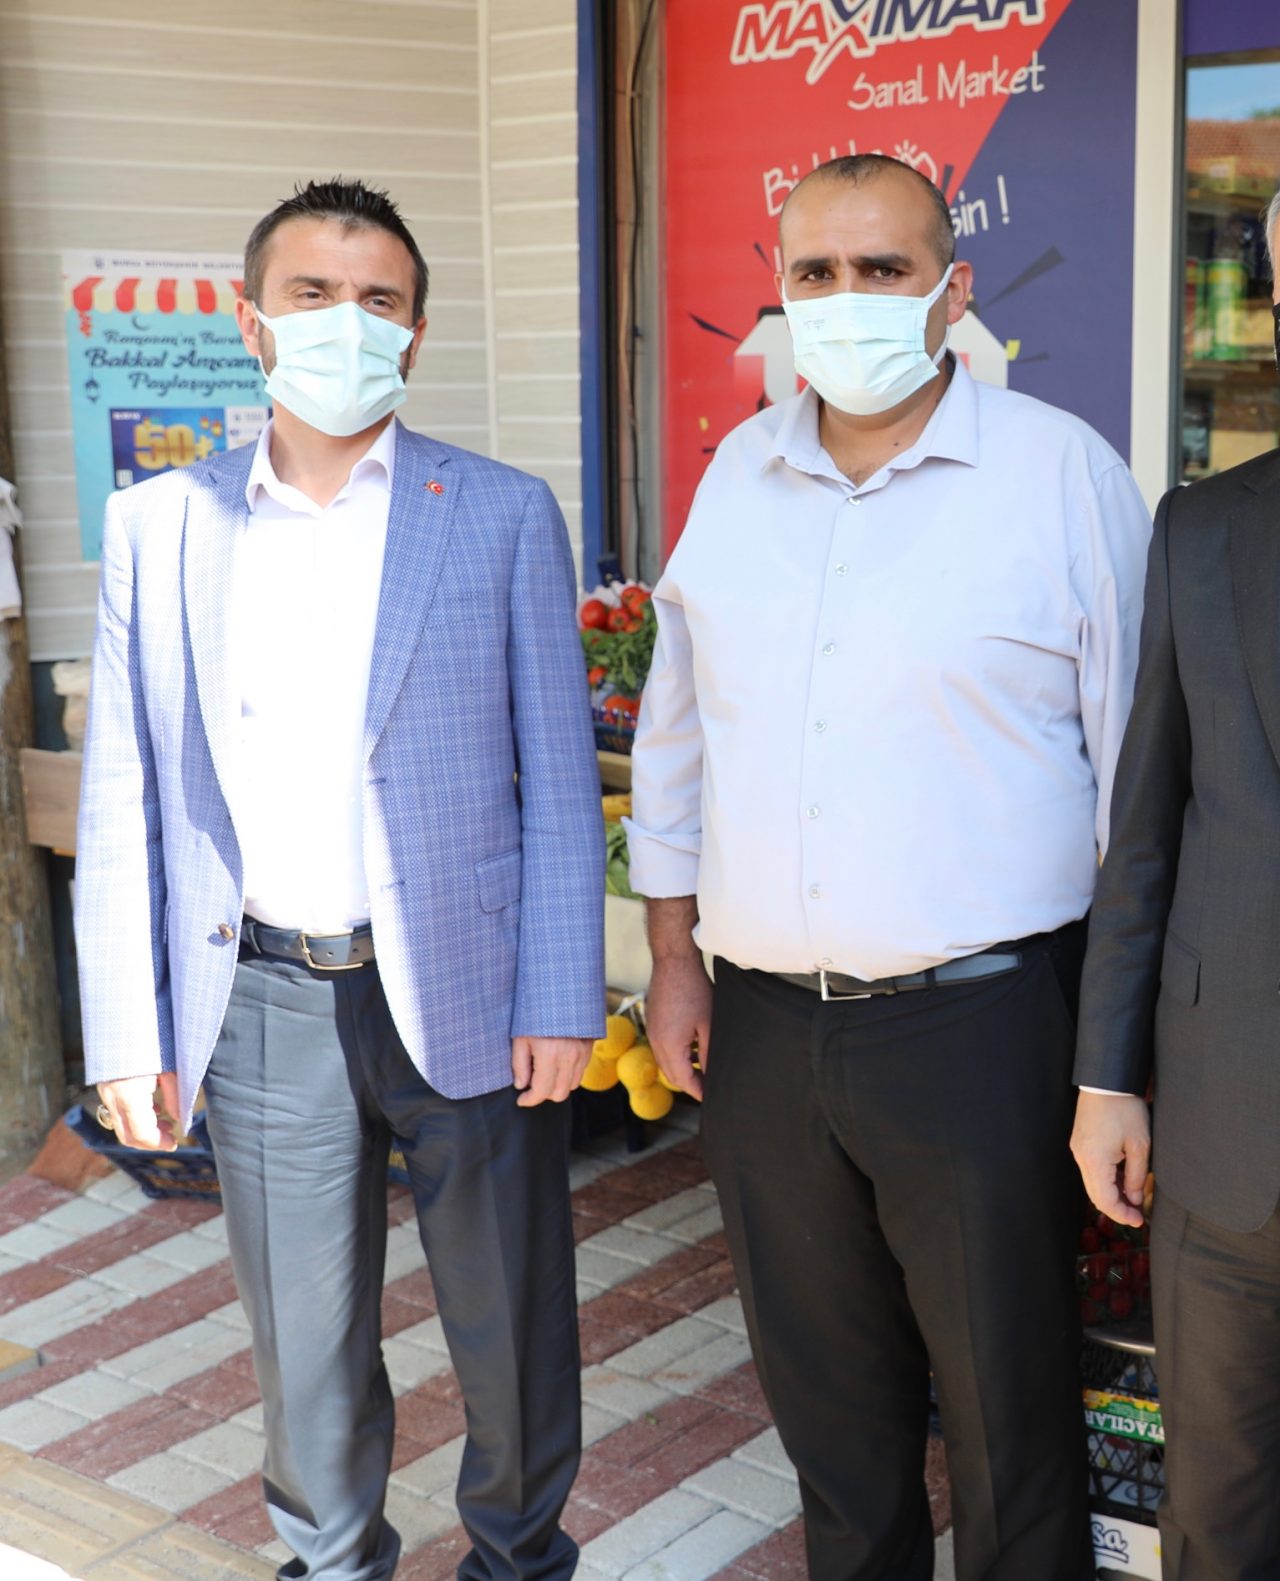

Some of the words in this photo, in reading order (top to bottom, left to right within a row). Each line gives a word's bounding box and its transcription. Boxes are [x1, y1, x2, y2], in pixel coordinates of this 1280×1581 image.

[848, 65, 929, 110] Sanal
[937, 51, 1046, 108] Market
[84, 349, 168, 370] Bakkal
